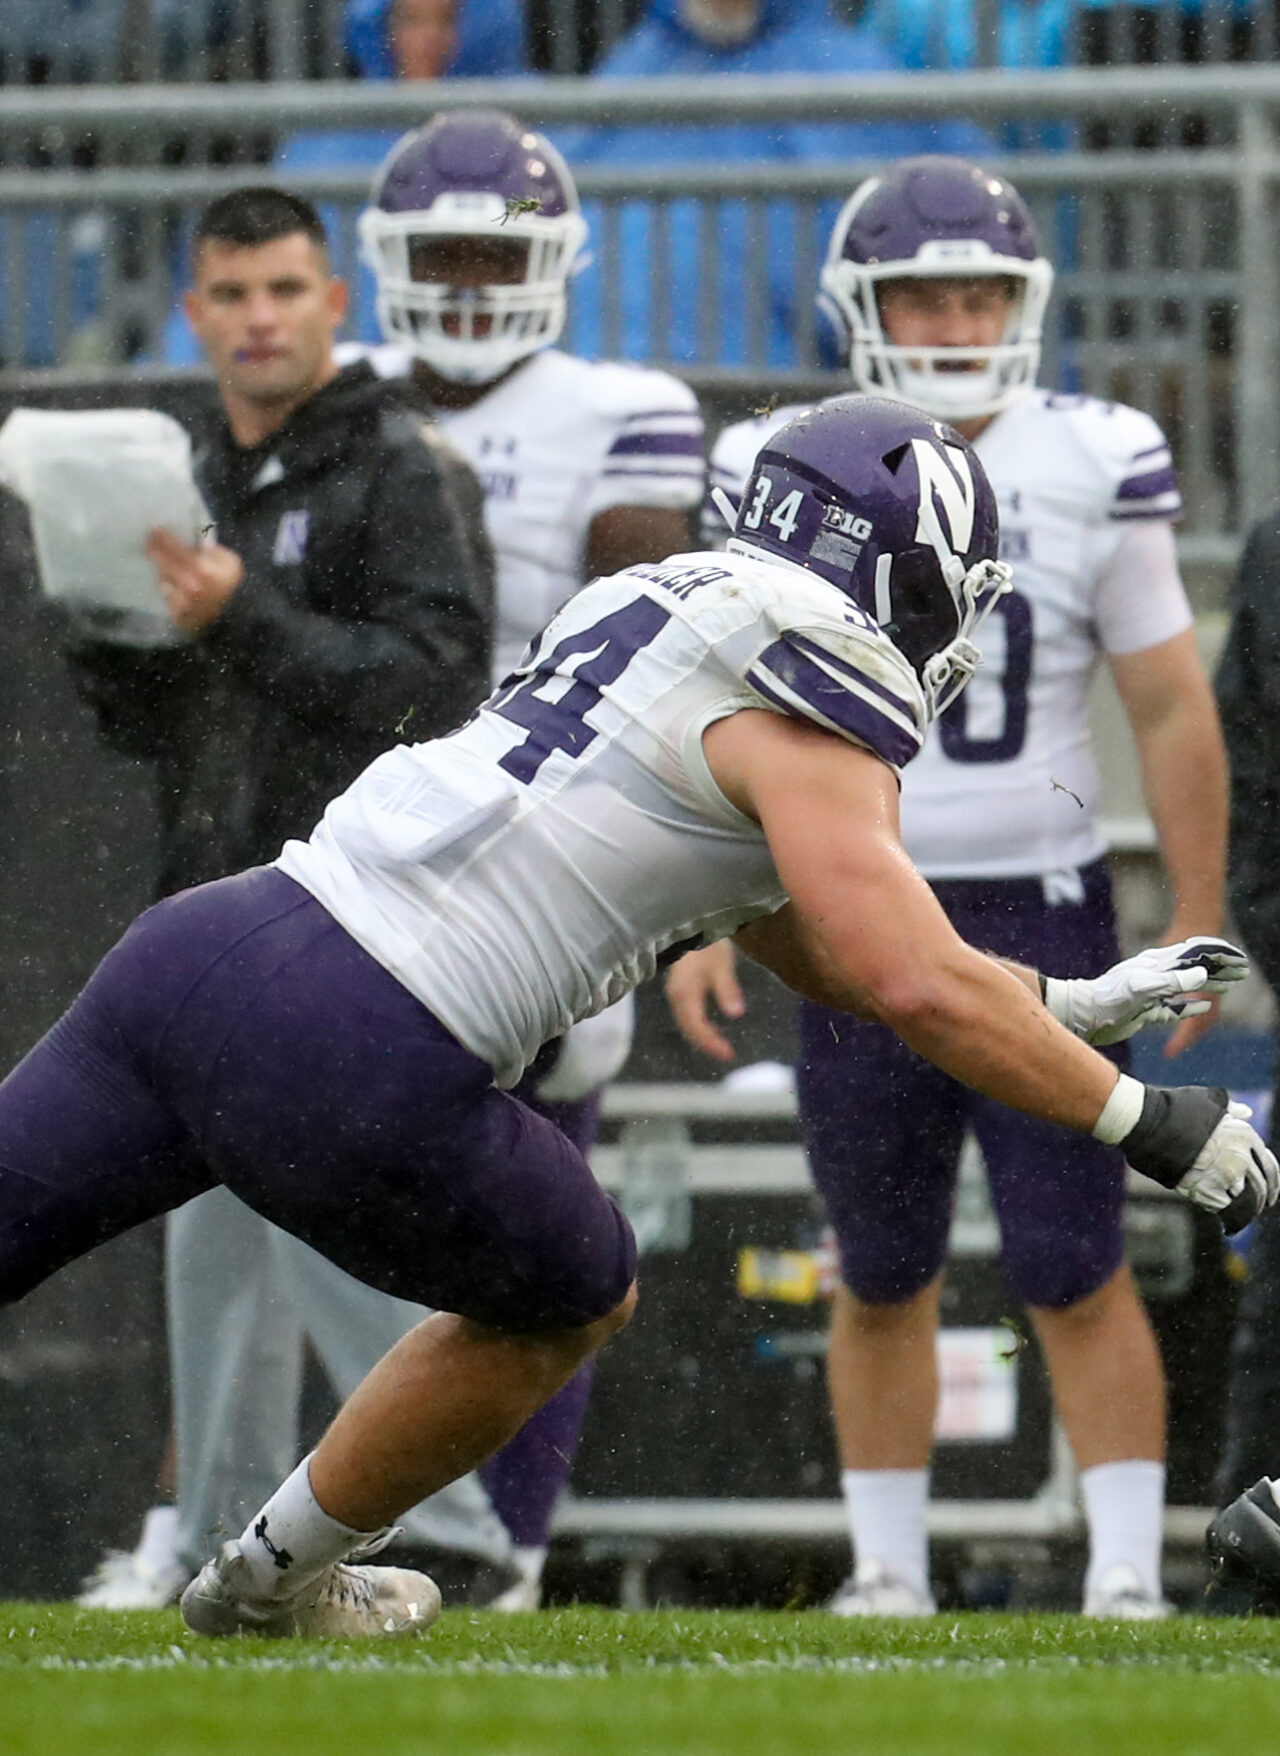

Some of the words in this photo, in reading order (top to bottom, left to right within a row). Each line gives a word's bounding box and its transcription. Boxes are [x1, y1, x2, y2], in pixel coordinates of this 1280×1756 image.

[744, 476, 804, 542] 34
[911, 438, 977, 554] N
[484, 593, 672, 786] 4
